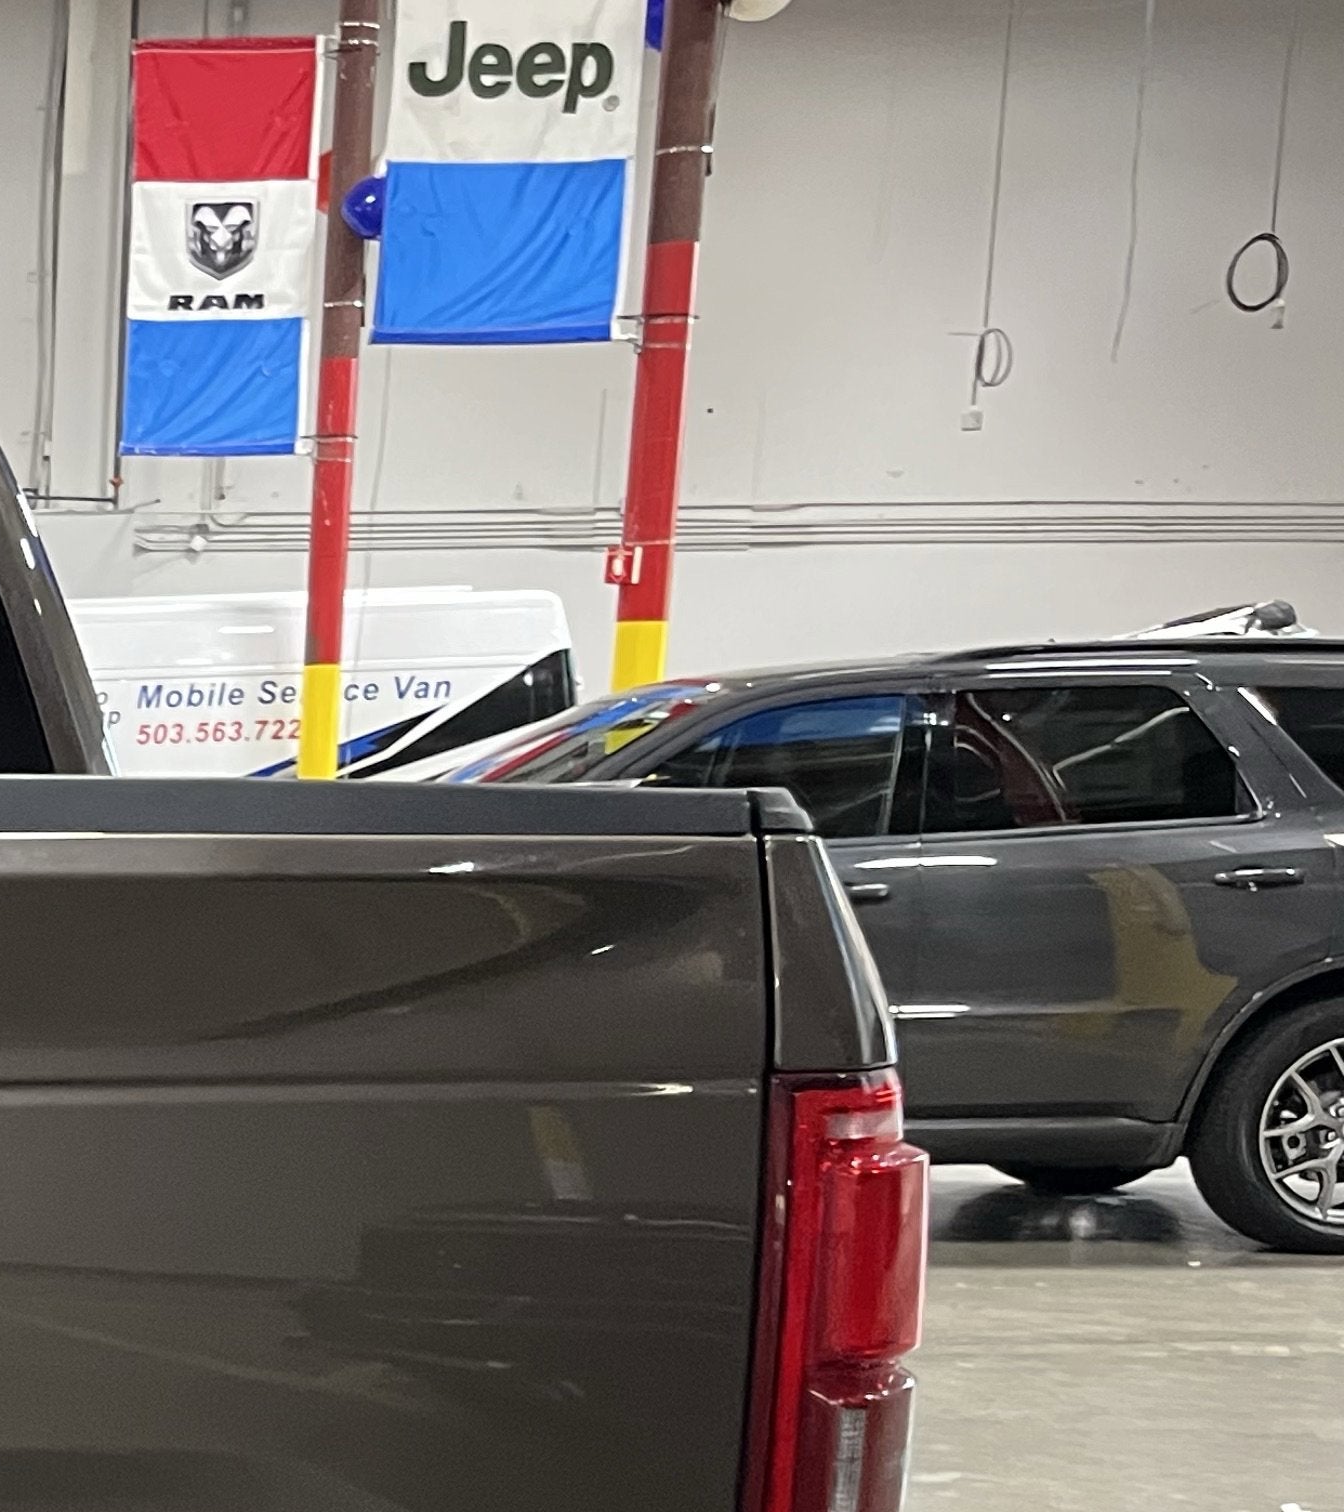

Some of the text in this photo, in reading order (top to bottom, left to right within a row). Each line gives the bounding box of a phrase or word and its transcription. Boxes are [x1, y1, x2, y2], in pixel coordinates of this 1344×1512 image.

[408, 20, 614, 113] Jeep
[167, 294, 265, 311] RAM
[137, 675, 452, 709] Mobile Sece Van
[136, 719, 302, 745] 503.563.722
